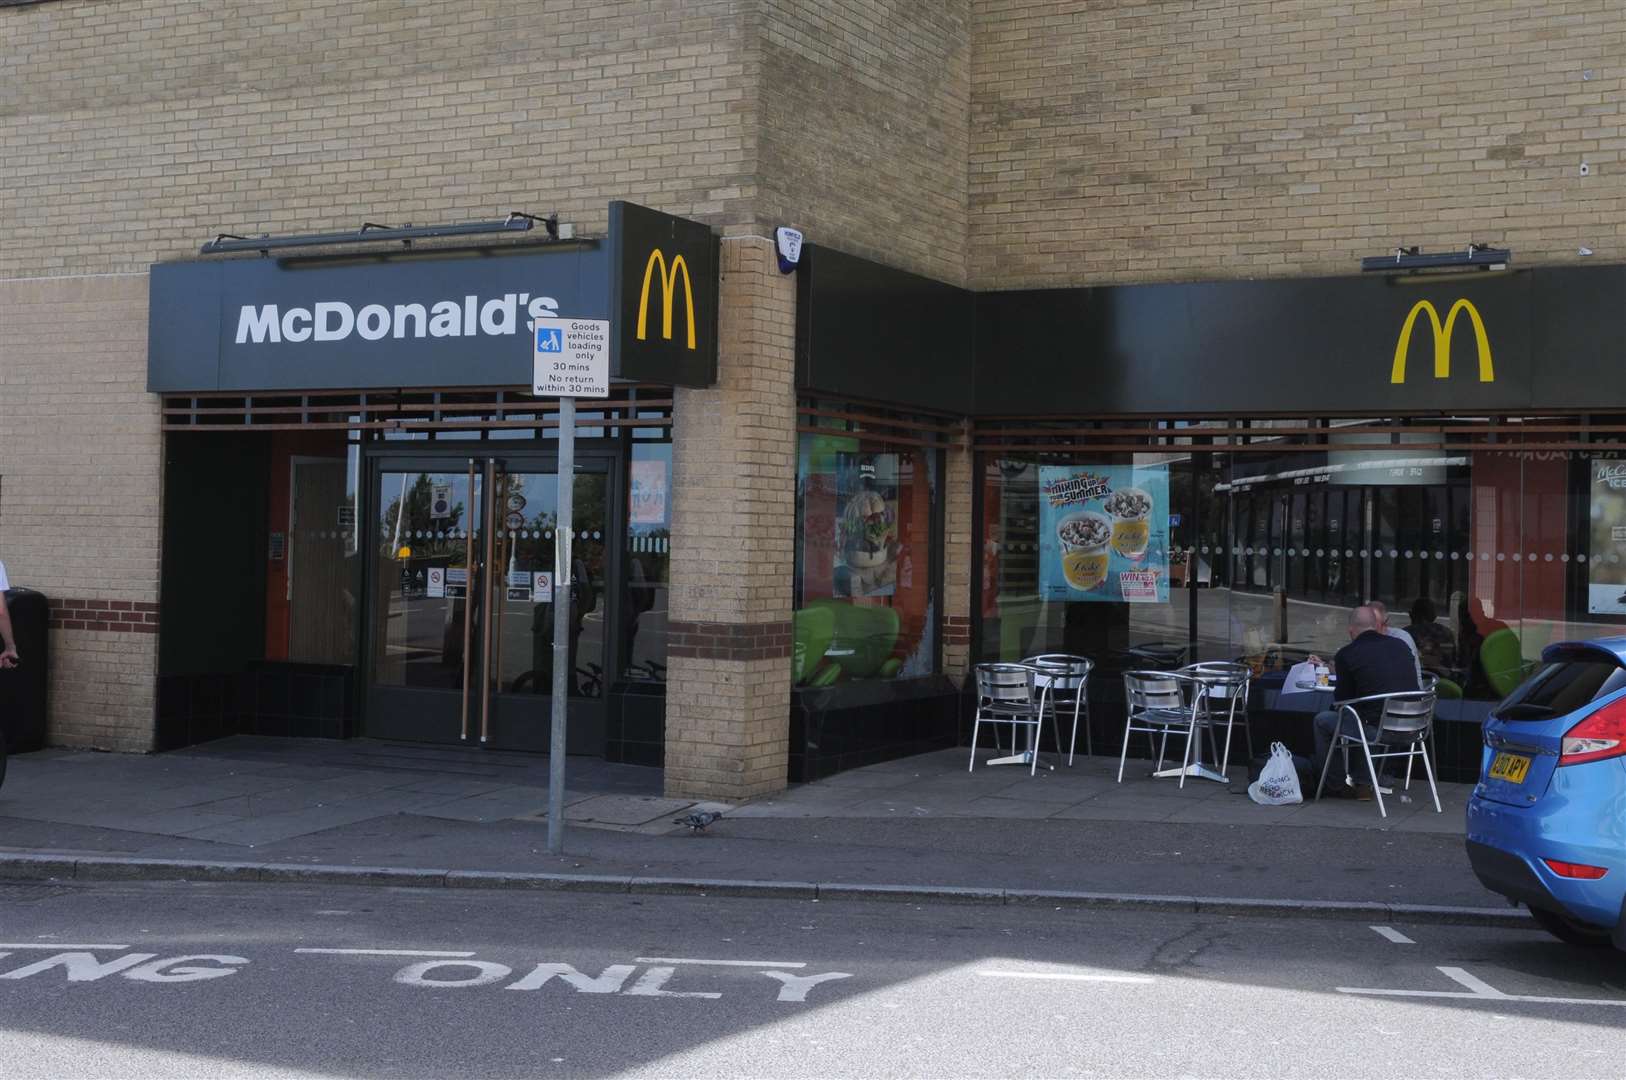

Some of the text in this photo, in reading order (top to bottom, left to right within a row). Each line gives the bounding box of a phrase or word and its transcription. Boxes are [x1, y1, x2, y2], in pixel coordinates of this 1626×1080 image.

[235, 293, 559, 344] McDonald's
[571, 322, 600, 331] Goods
[567, 332, 604, 341] vehicles
[568, 342, 602, 351] loading
[575, 352, 595, 361] only
[553, 362, 590, 371] 30 mins
[549, 374, 562, 382] No
[537, 384, 565, 392] within
[568, 385, 582, 393] 30
[1051, 478, 1088, 494] MIXING
[1064, 484, 1108, 502] SUMMER
[1121, 573, 1139, 581] WIN
[0, 952, 854, 1002] NG ONLY
